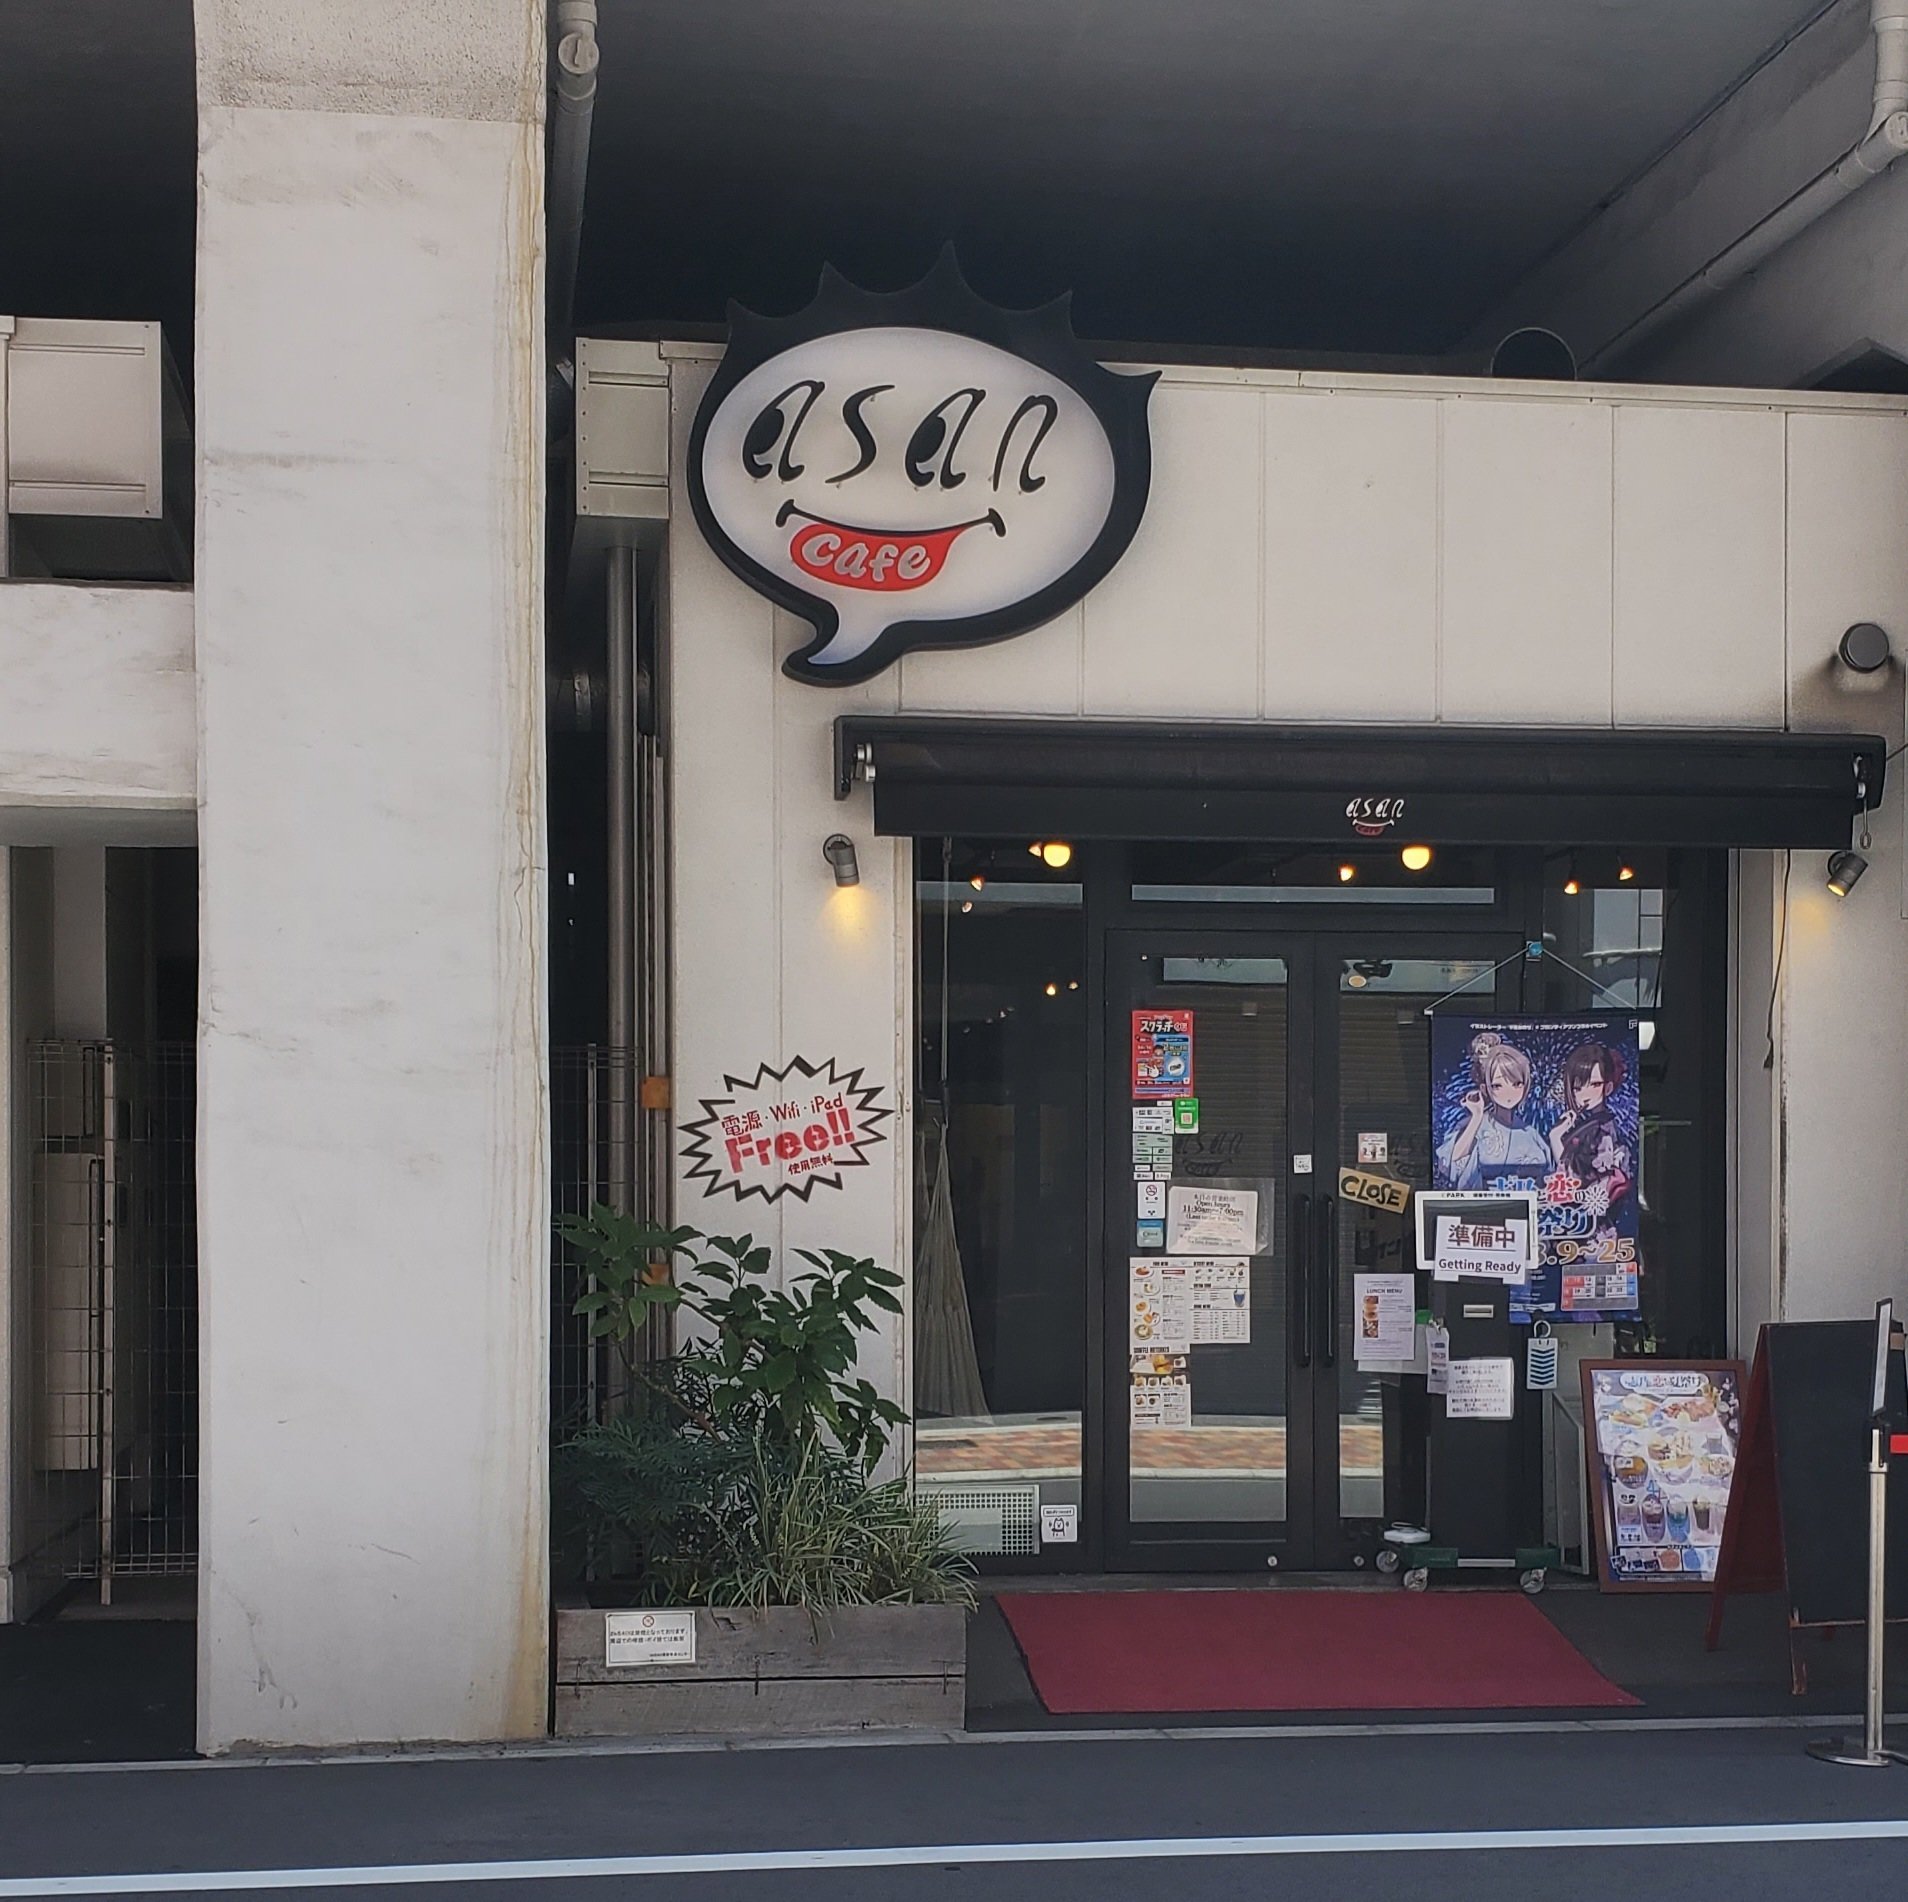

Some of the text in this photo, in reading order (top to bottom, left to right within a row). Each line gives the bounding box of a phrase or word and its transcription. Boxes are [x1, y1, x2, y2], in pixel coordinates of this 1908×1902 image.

[742, 379, 1059, 494] asan
[1345, 797, 1405, 818] asan
[724, 1107, 856, 1174] Free!!
[787, 1152, 834, 1176] 使用無料
[1341, 1176, 1402, 1206] CLOSE
[1448, 1224, 1516, 1250] 準備中
[1438, 1257, 1521, 1274] Getting Ready
